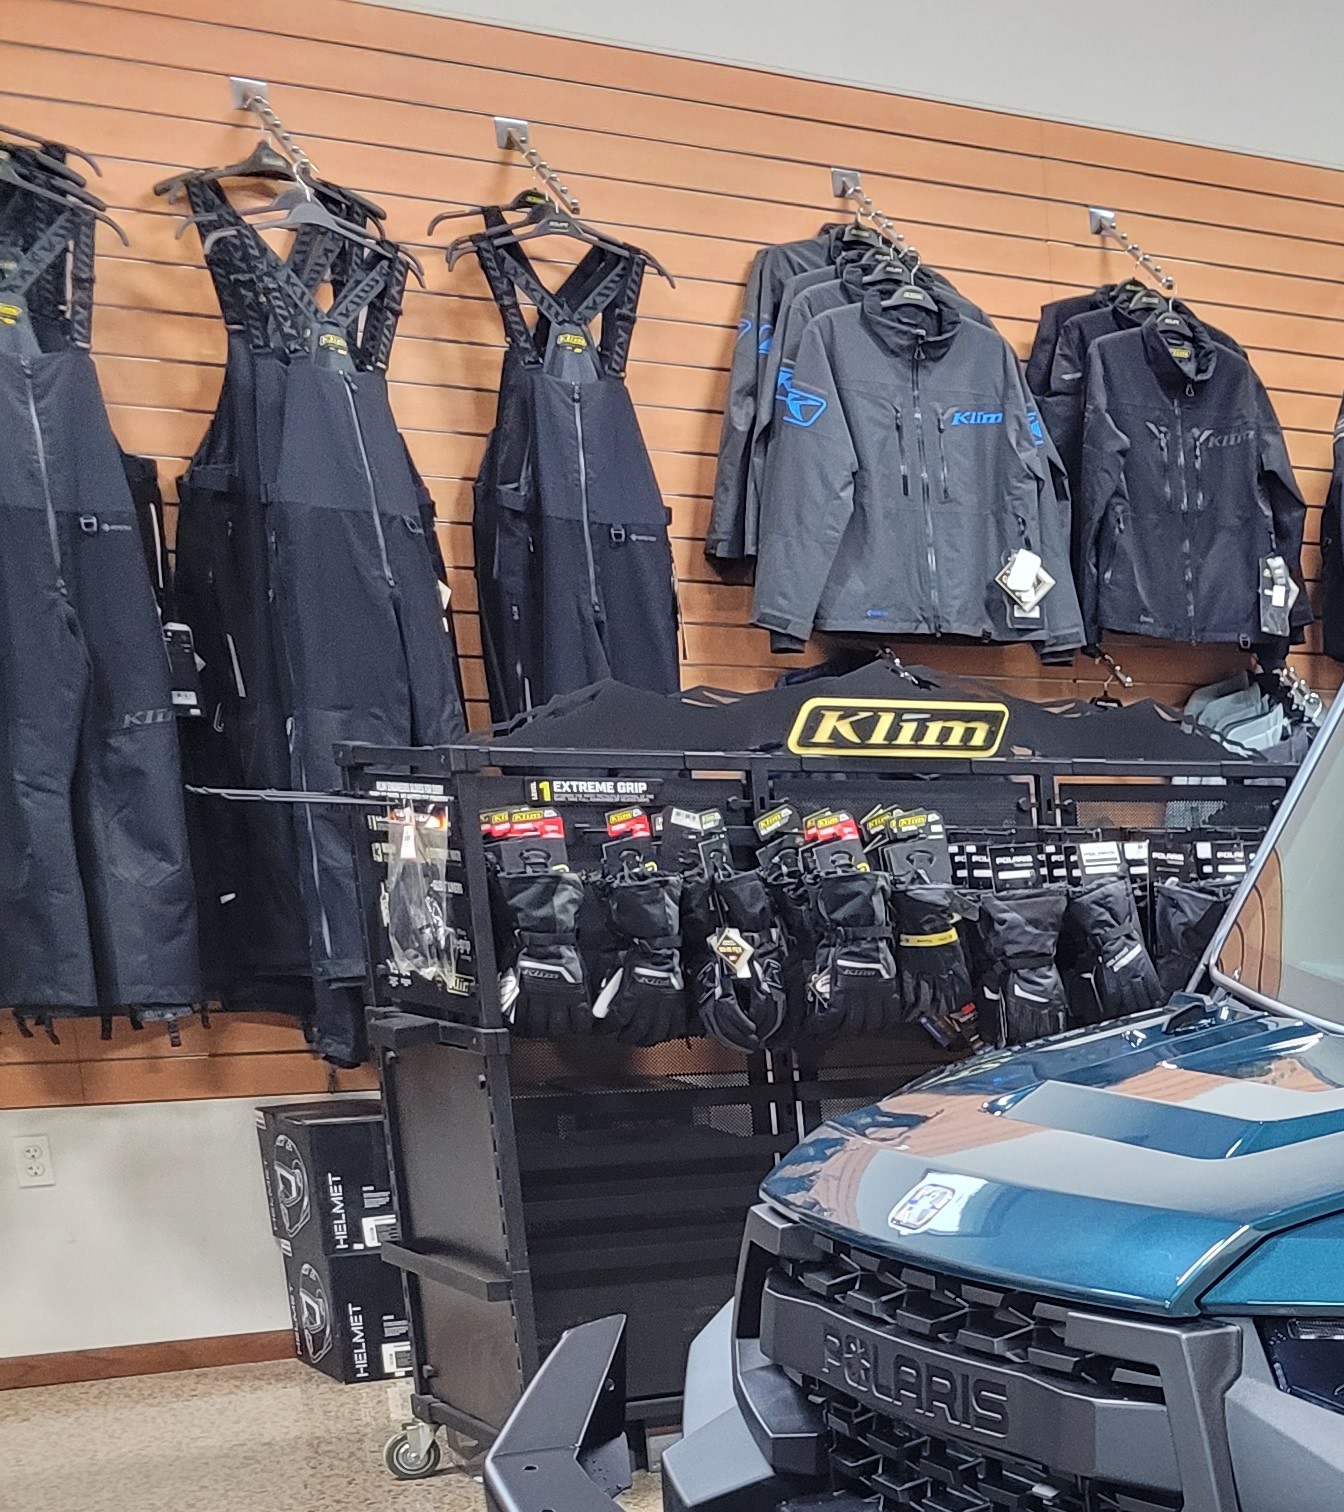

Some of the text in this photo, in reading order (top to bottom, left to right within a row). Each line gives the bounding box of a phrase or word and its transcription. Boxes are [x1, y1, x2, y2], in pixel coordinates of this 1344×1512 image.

[951, 411, 1004, 426] Klim
[807, 710, 990, 747] Klim
[540, 780, 551, 802] 1
[553, 781, 648, 794] EXTREME GRIP
[327, 1172, 350, 1250] HELMET
[347, 1302, 370, 1378] HELMET
[820, 1322, 1009, 1439] POLARIS
